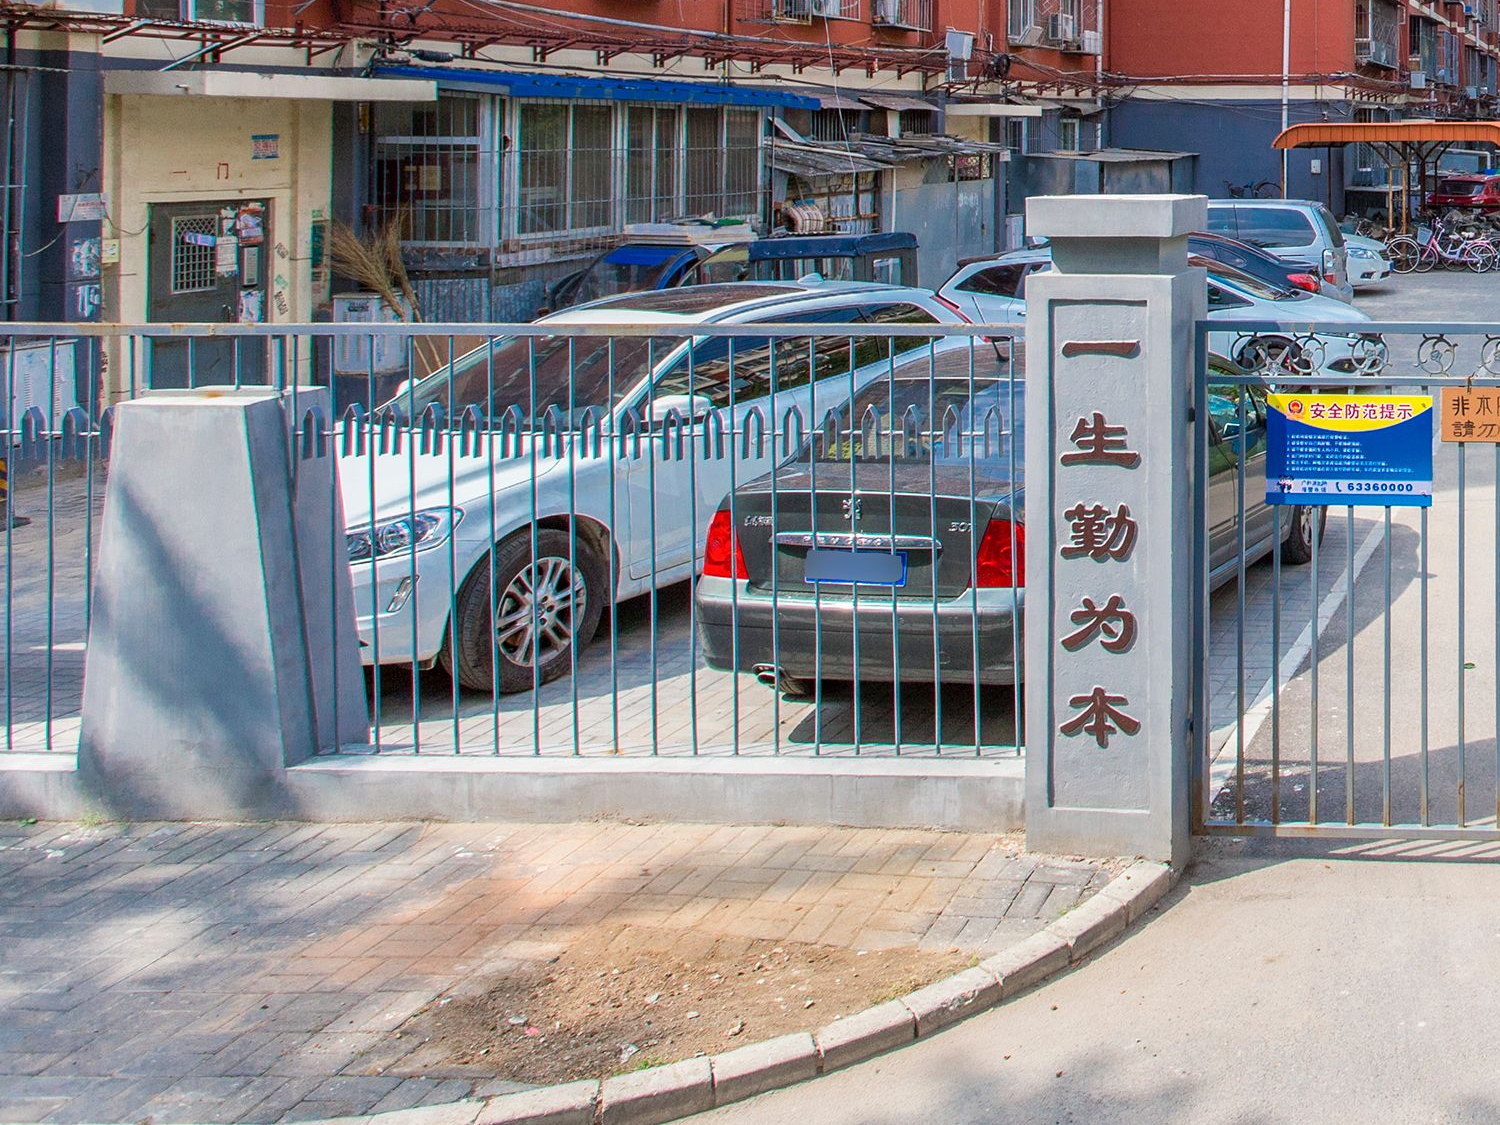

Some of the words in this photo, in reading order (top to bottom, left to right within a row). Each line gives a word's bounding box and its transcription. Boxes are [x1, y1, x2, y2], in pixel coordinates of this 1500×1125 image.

[1310, 403, 1413, 420] 安全防范提示
[1347, 482, 1413, 492] 63360000
[1060, 339, 1142, 749] 一生勤为本
